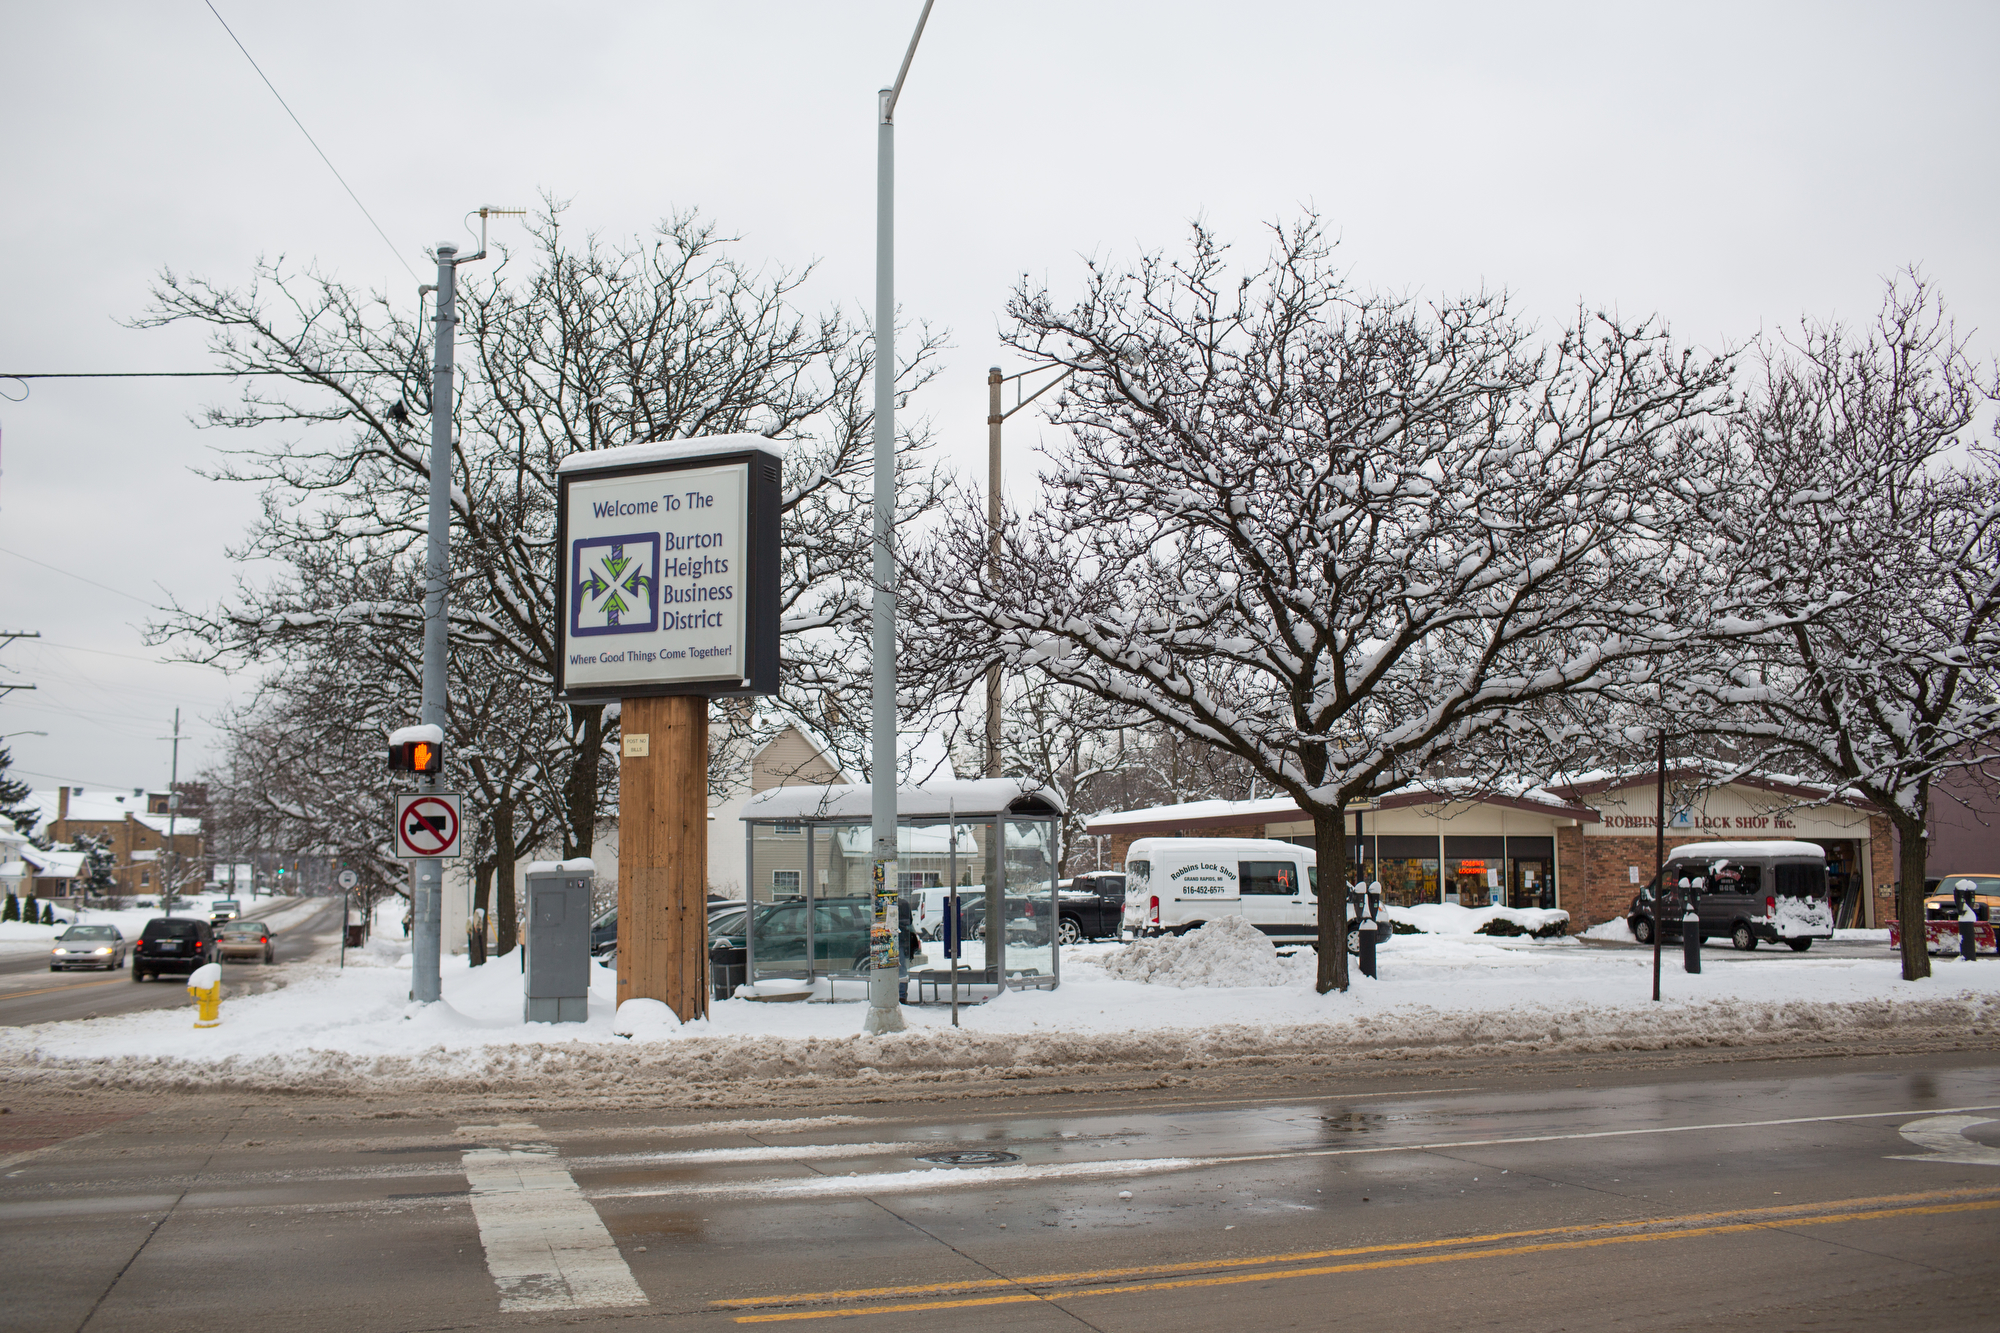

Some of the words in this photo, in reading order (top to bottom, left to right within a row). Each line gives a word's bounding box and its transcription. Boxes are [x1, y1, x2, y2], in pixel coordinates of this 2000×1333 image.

[593, 500, 659, 519] Welcome
[663, 494, 681, 512] To
[685, 492, 714, 509] The
[665, 532, 723, 551] Burton
[664, 555, 729, 579] Heights
[664, 582, 733, 604] Business
[663, 609, 723, 631] District
[570, 654, 597, 665] Where
[599, 651, 624, 663] Good
[627, 650, 657, 662] Things
[659, 648, 686, 660] Come
[688, 645, 732, 659] Together!
[1605, 815, 1665, 828] ROBBIN
[1695, 816, 1731, 829] LOCK
[1735, 816, 1769, 829] SHOP
[1774, 816, 1796, 829] inc.
[1170, 864, 1199, 881] Robbins
[1200, 862, 1218, 871] Lock
[1219, 865, 1237, 881] Shop
[1182, 886, 1225, 894] 616-452-6575
